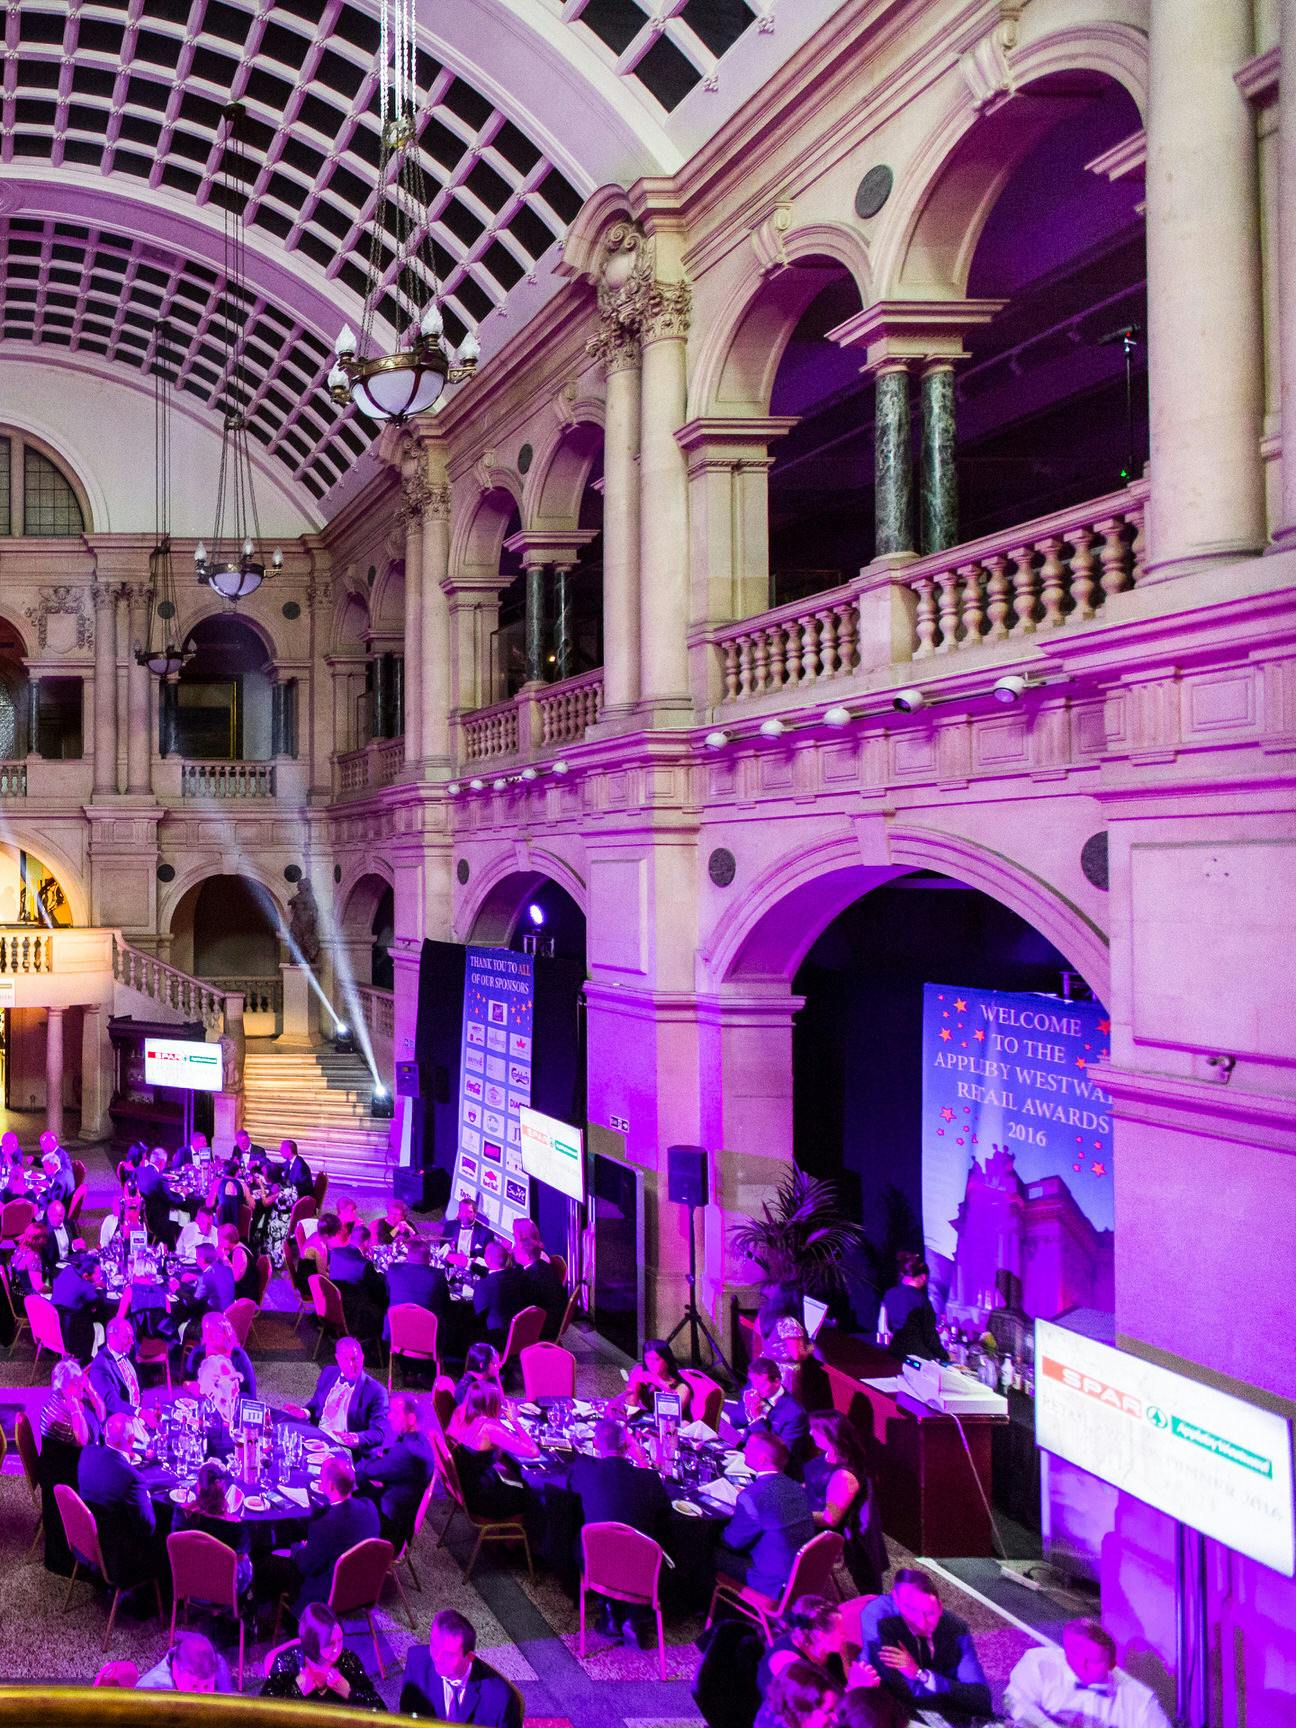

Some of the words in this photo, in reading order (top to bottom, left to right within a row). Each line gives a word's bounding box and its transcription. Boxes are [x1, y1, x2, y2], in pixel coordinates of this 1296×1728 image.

[470, 956, 492, 970] THANK
[493, 960, 507, 972] YOU
[508, 962, 517, 974] TO
[518, 964, 531, 976] ALL
[472, 973, 480, 984] OF
[481, 975, 494, 988] OUR
[494, 977, 529, 995] SPONSORS
[980, 1004, 1082, 1037] WELCOME
[992, 1034, 1018, 1054] TO
[1023, 1040, 1066, 1064] THE
[1016, 1066, 1113, 1105] WESTWA
[957, 1081, 1017, 1111] RETAIL
[1022, 1098, 1109, 1134] AWARDS
[1008, 1122, 1047, 1147] 2016
[1061, 1368, 1142, 1418] SPAR
